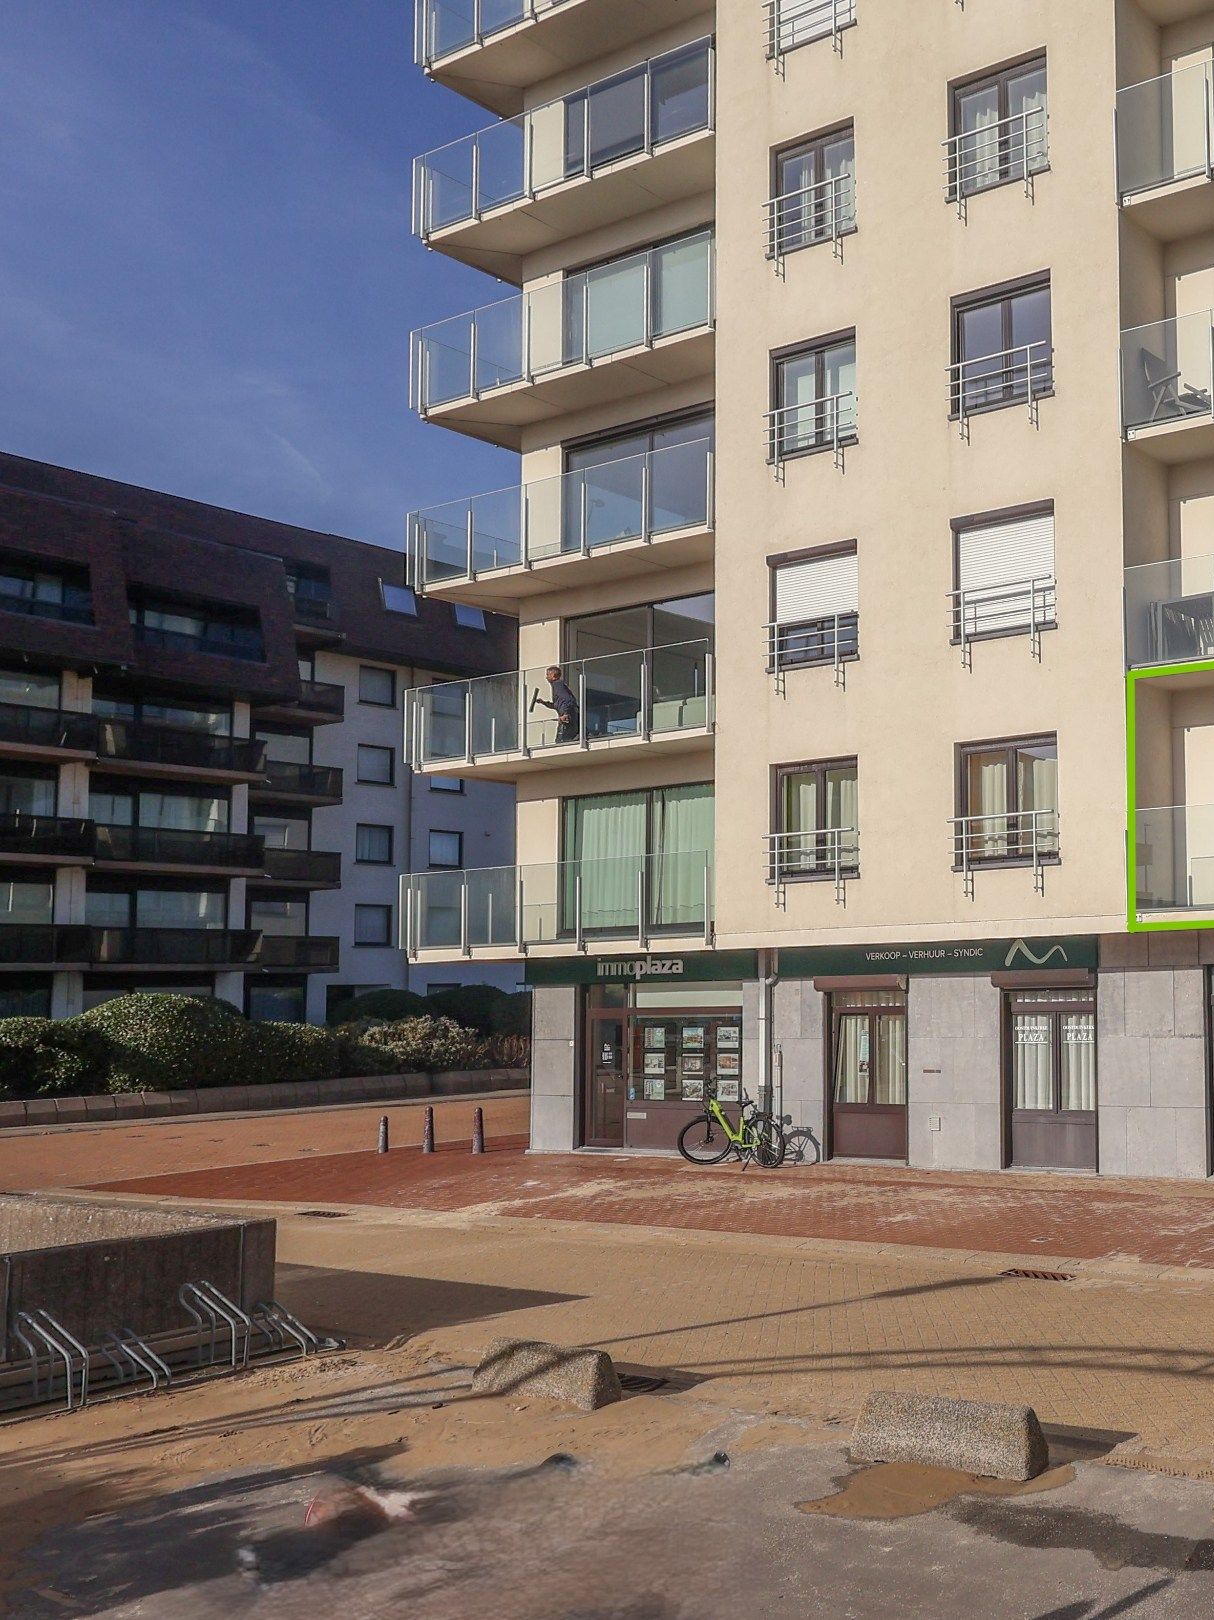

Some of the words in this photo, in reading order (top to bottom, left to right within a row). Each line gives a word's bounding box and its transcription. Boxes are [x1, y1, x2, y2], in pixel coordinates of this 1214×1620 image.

[865, 951, 901, 960] VERKOOP
[909, 949, 945, 959] VERHUUR
[953, 947, 983, 957] SYNDIC
[597, 955, 684, 980] immoplaza
[1018, 1033, 1044, 1041] PLAZA
[1066, 1032, 1093, 1040] PLAZA
